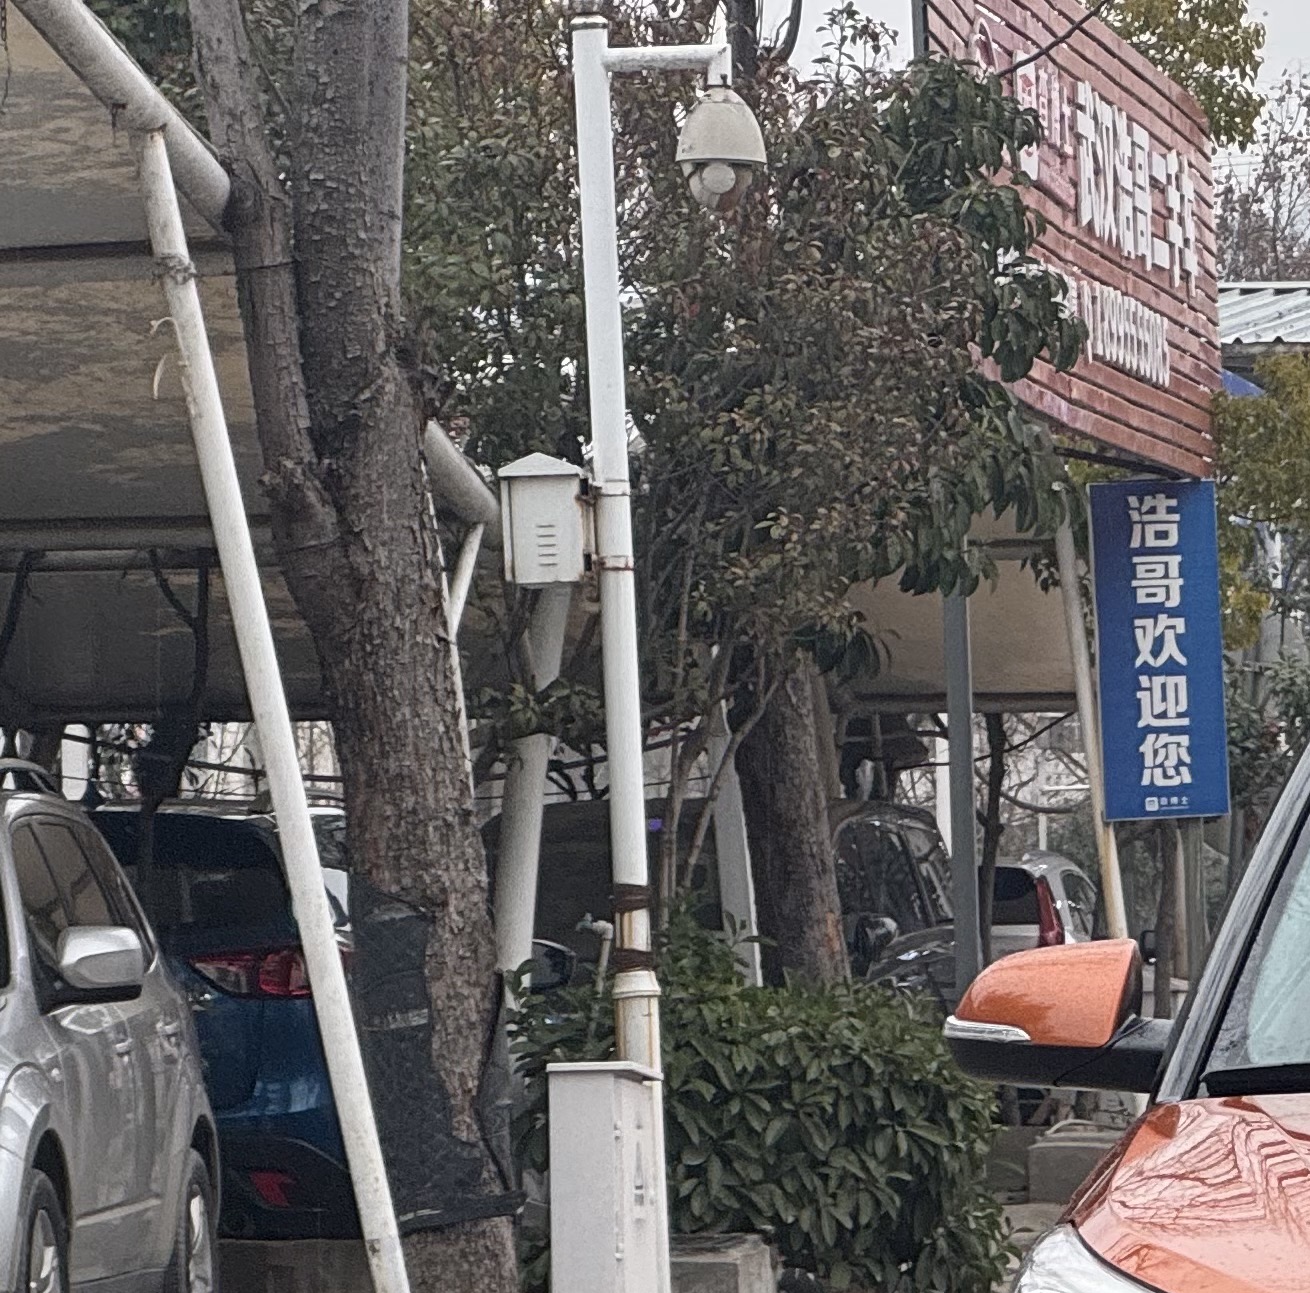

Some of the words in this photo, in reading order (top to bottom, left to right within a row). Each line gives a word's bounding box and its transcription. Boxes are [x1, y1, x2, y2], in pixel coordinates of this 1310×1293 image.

[1076, 80, 1199, 296] 武汉浩哥二手车
[1126, 493, 1193, 788] 浩哥欢迎您
